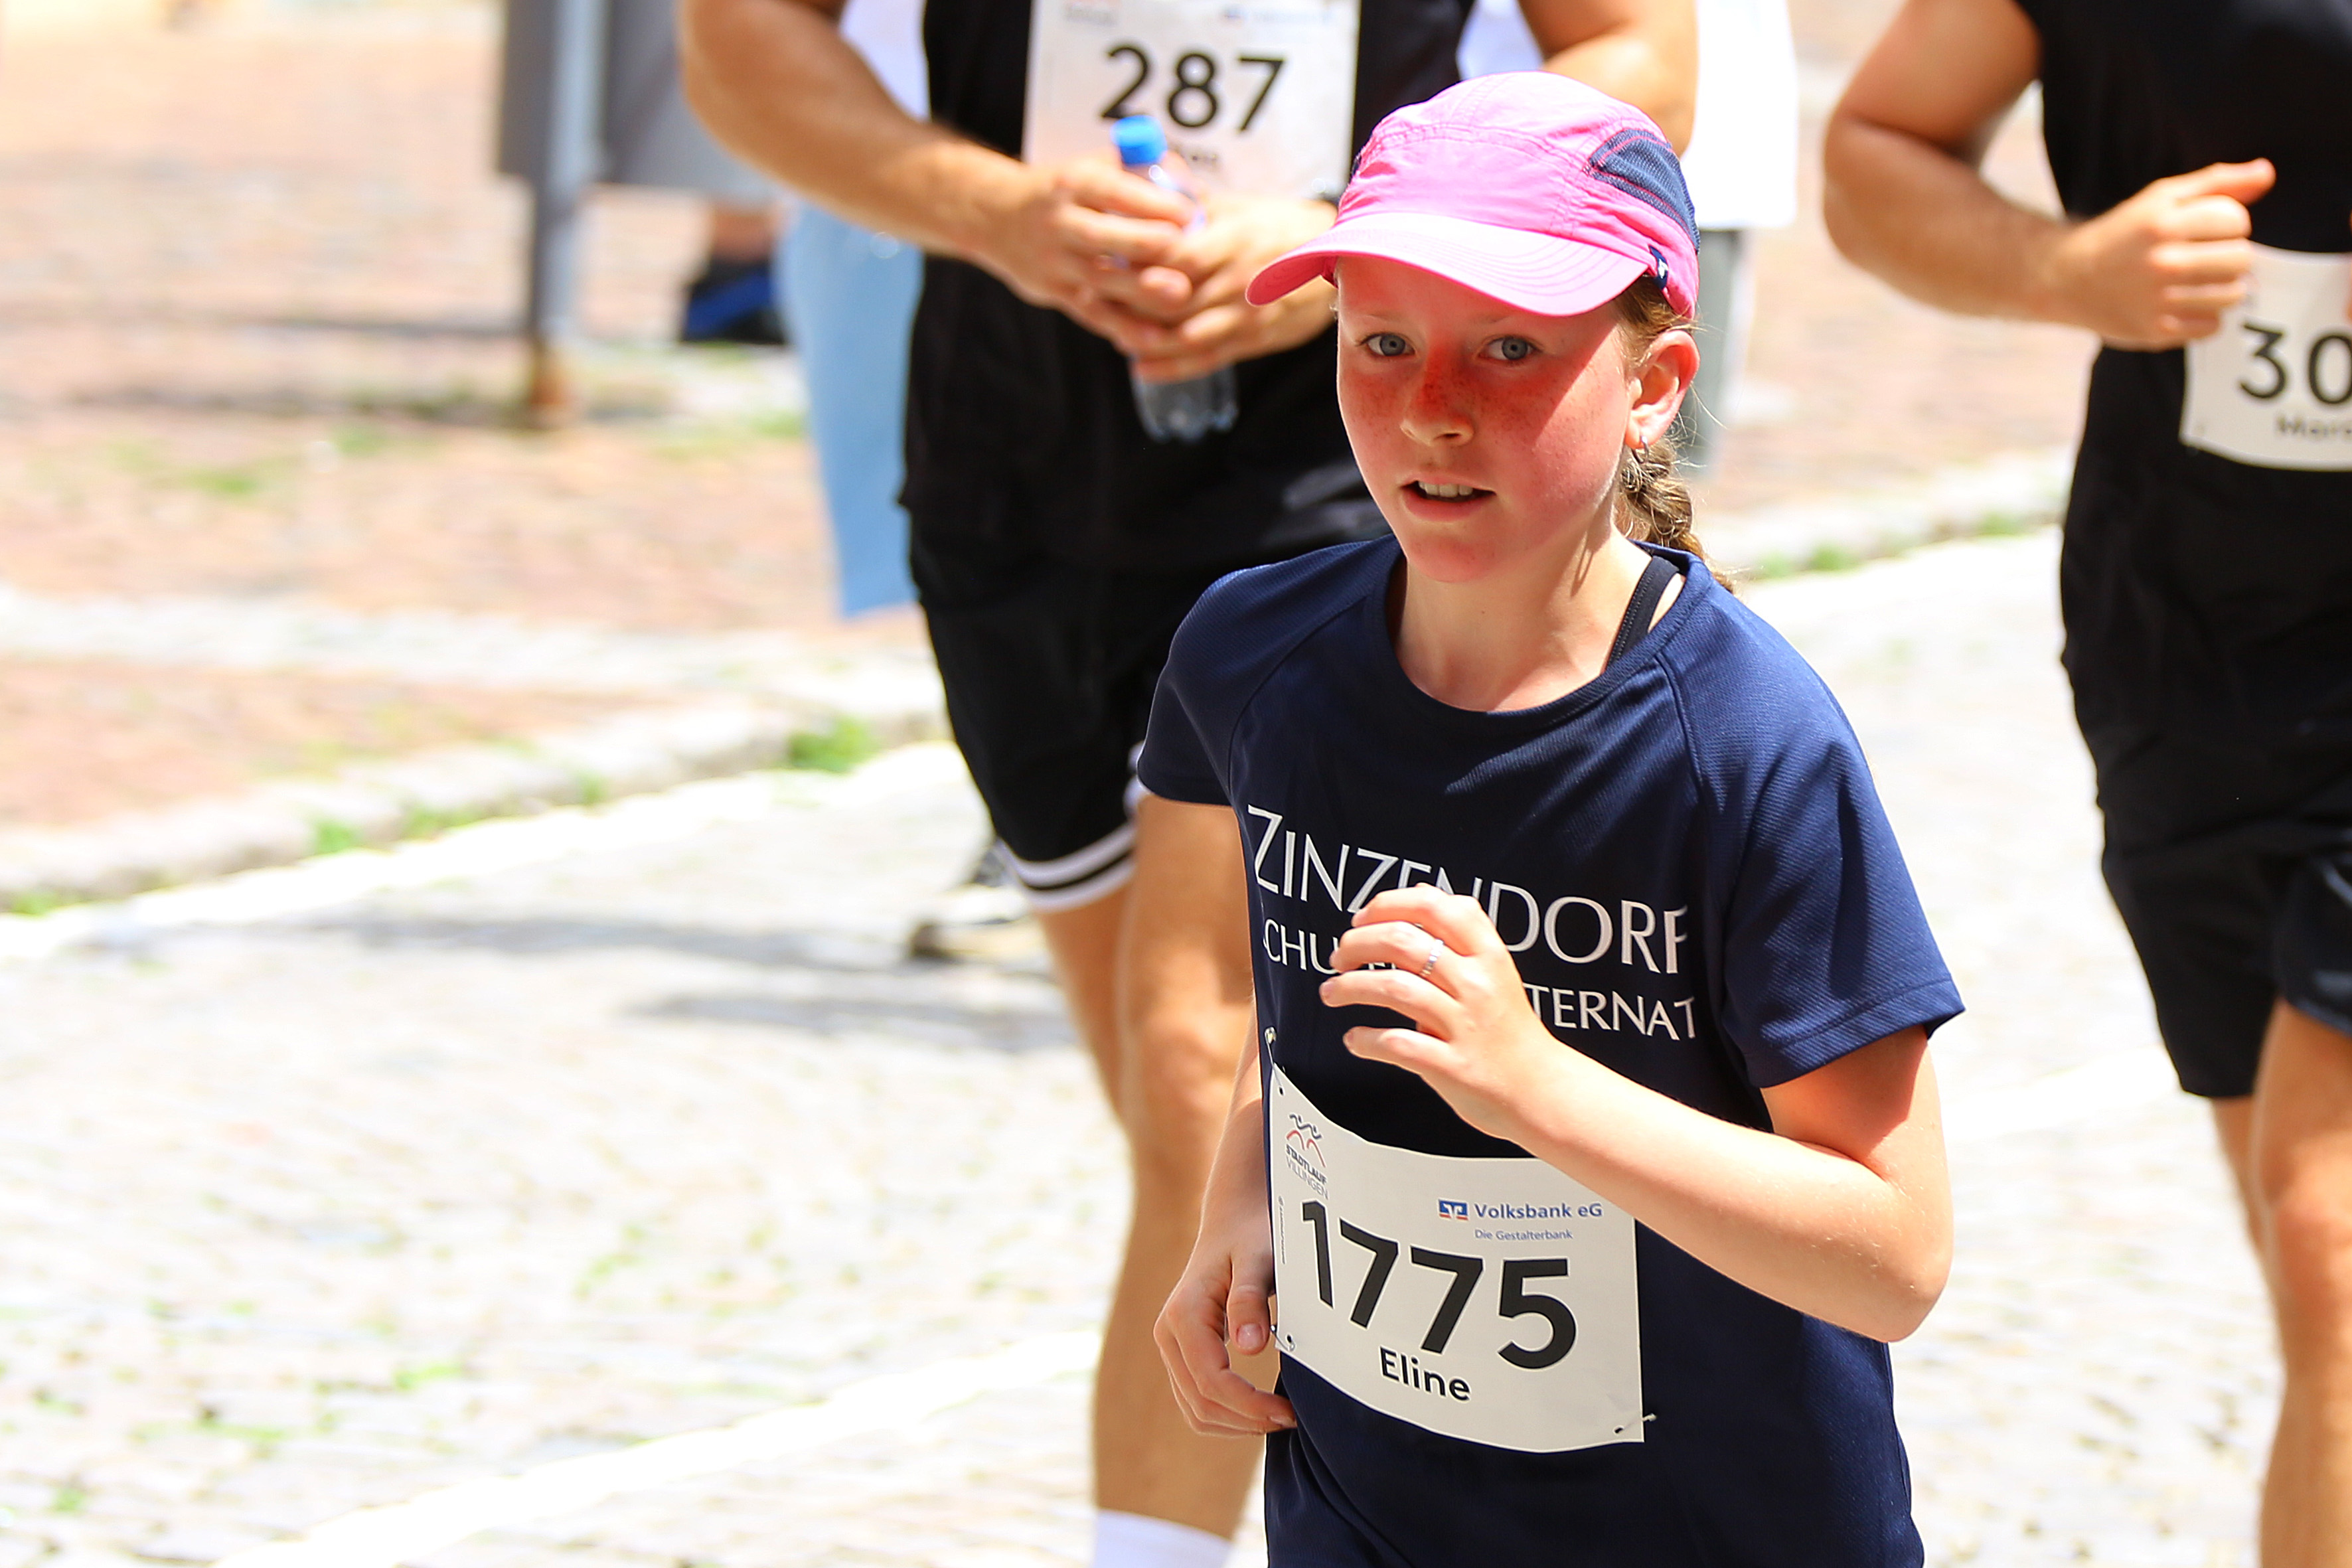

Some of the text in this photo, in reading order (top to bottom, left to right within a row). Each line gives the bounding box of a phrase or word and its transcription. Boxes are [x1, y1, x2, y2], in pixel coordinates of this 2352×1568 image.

[1100, 44, 1286, 132] 287
[2237, 321, 2352, 405] 30
[1474, 1203, 1603, 1219] Volksbank eG
[1474, 1229, 1573, 1241] Die Gestalterbank
[1302, 1202, 1576, 1370] 1775
[1380, 1347, 1470, 1401] Eline
